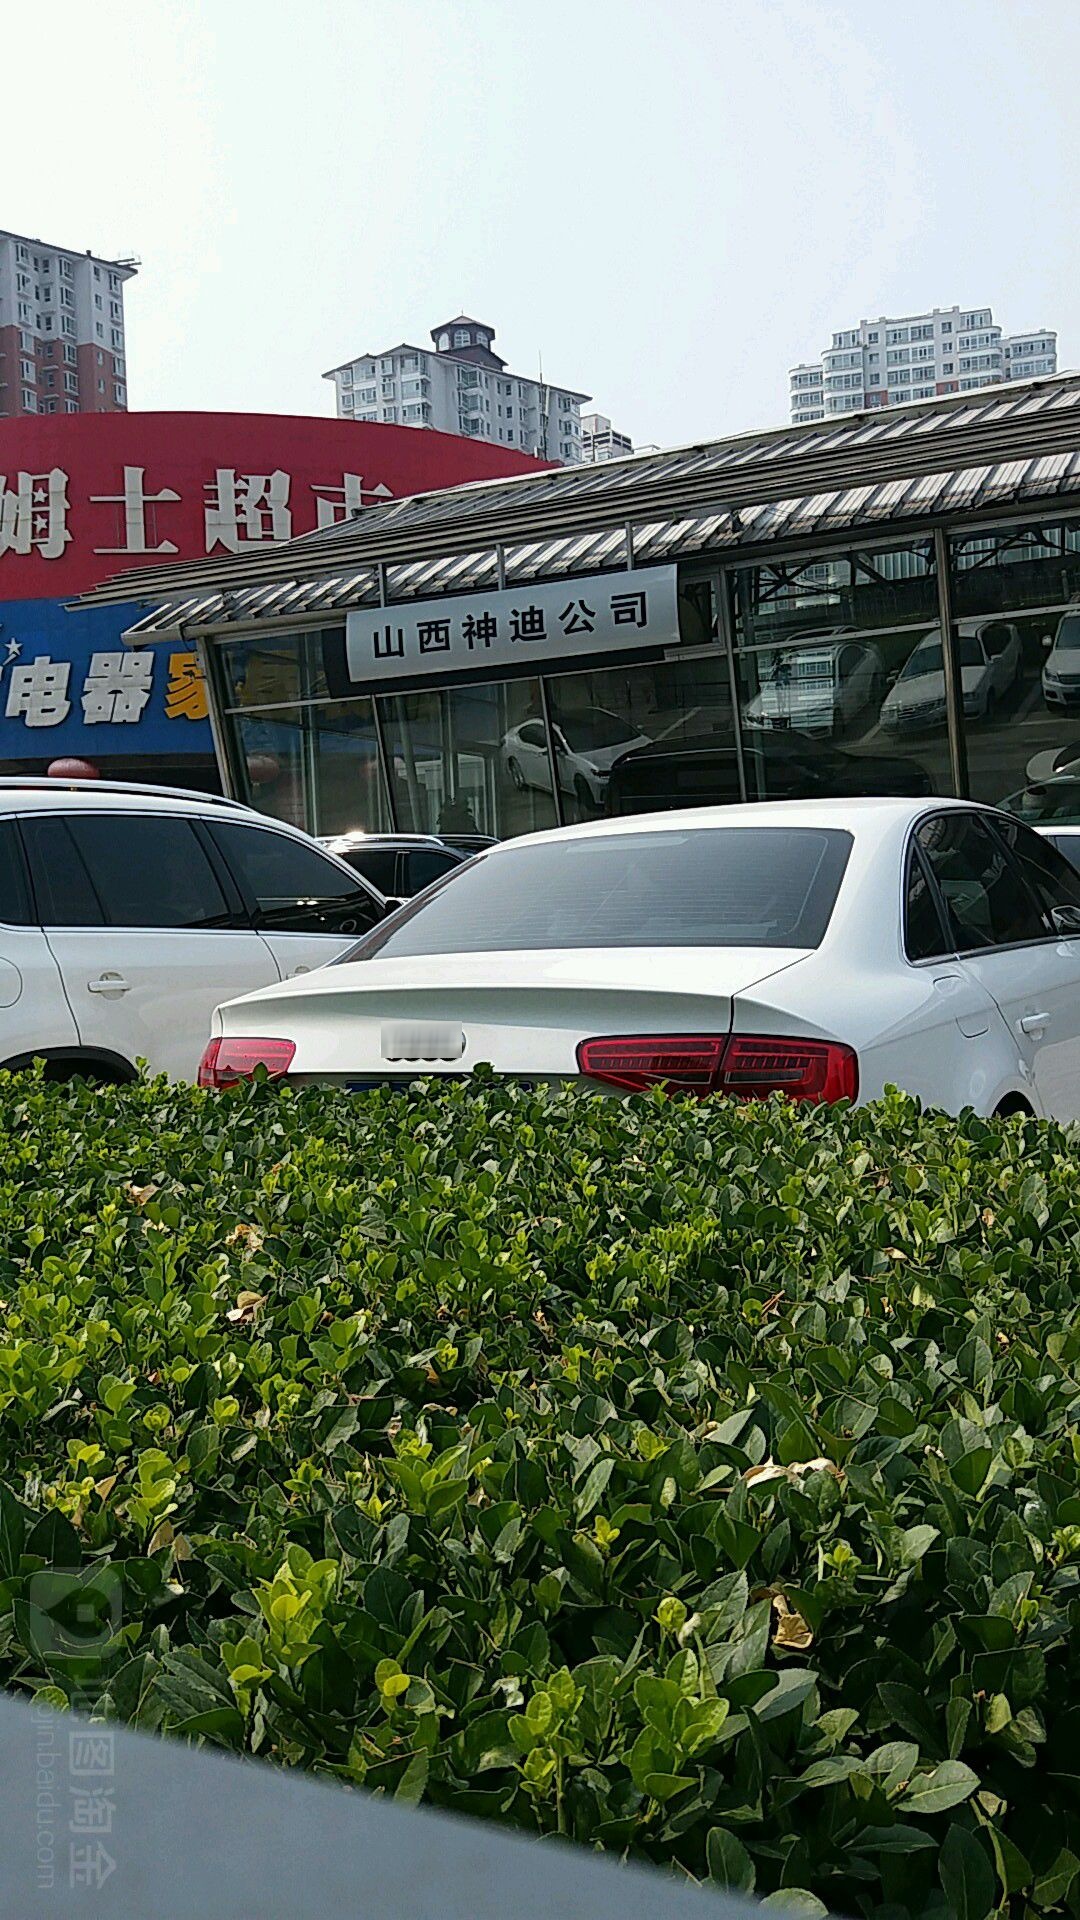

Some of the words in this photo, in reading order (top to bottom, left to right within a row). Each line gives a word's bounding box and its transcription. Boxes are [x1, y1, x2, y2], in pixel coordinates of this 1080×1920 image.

[373, 591, 648, 659] 山西神迪公司
